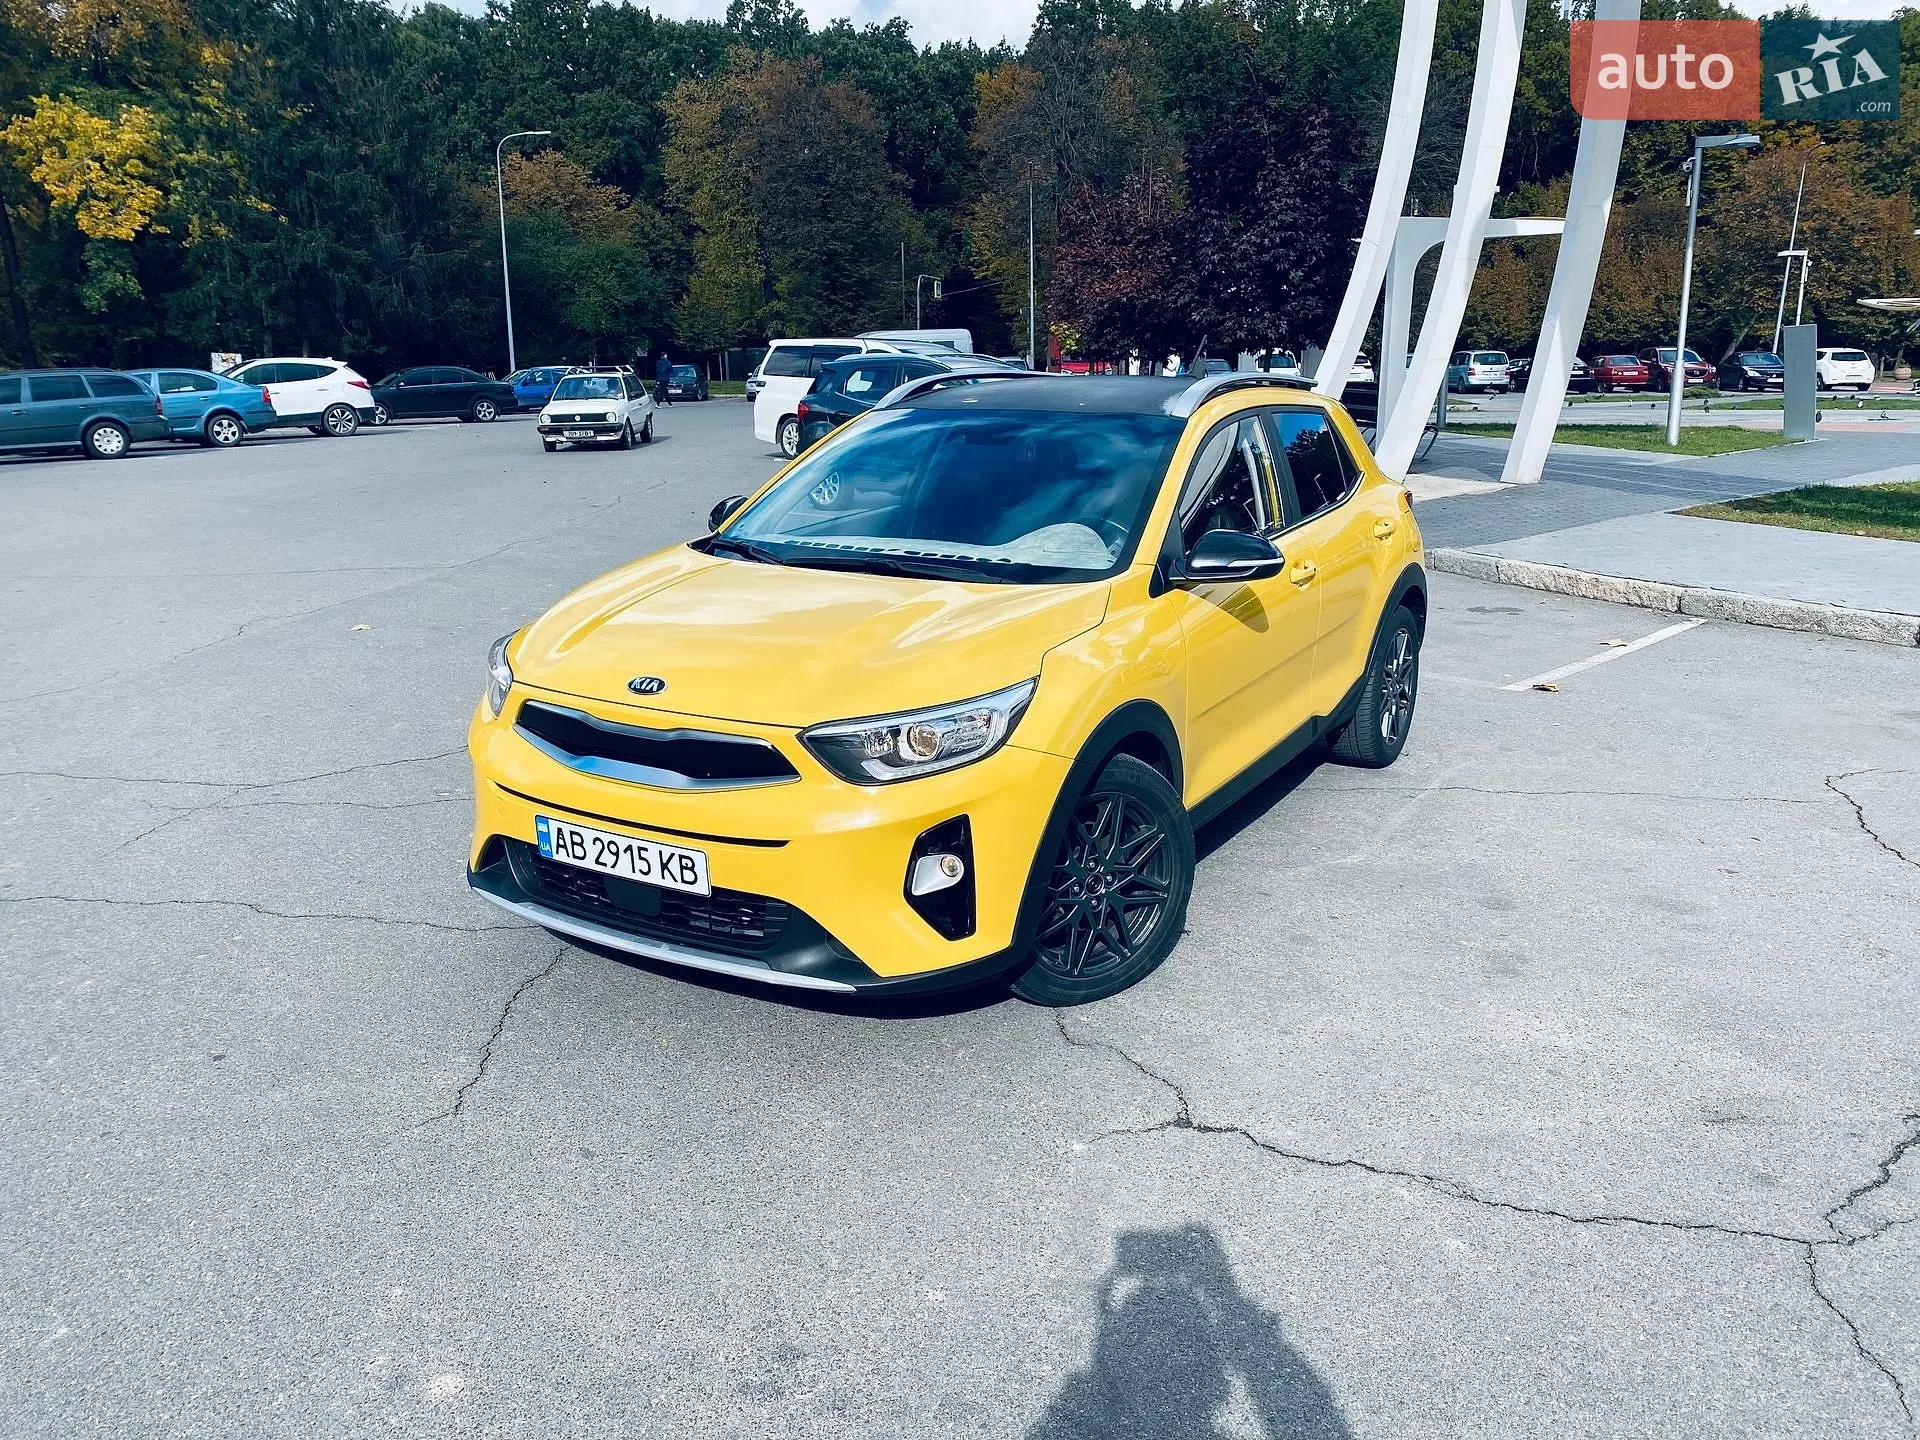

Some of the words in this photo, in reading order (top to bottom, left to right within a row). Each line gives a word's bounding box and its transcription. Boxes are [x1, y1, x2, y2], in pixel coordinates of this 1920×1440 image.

[630, 677, 660, 692] KIA
[555, 827, 587, 860] AB
[592, 836, 651, 876] 2915
[658, 850, 698, 886] KB
